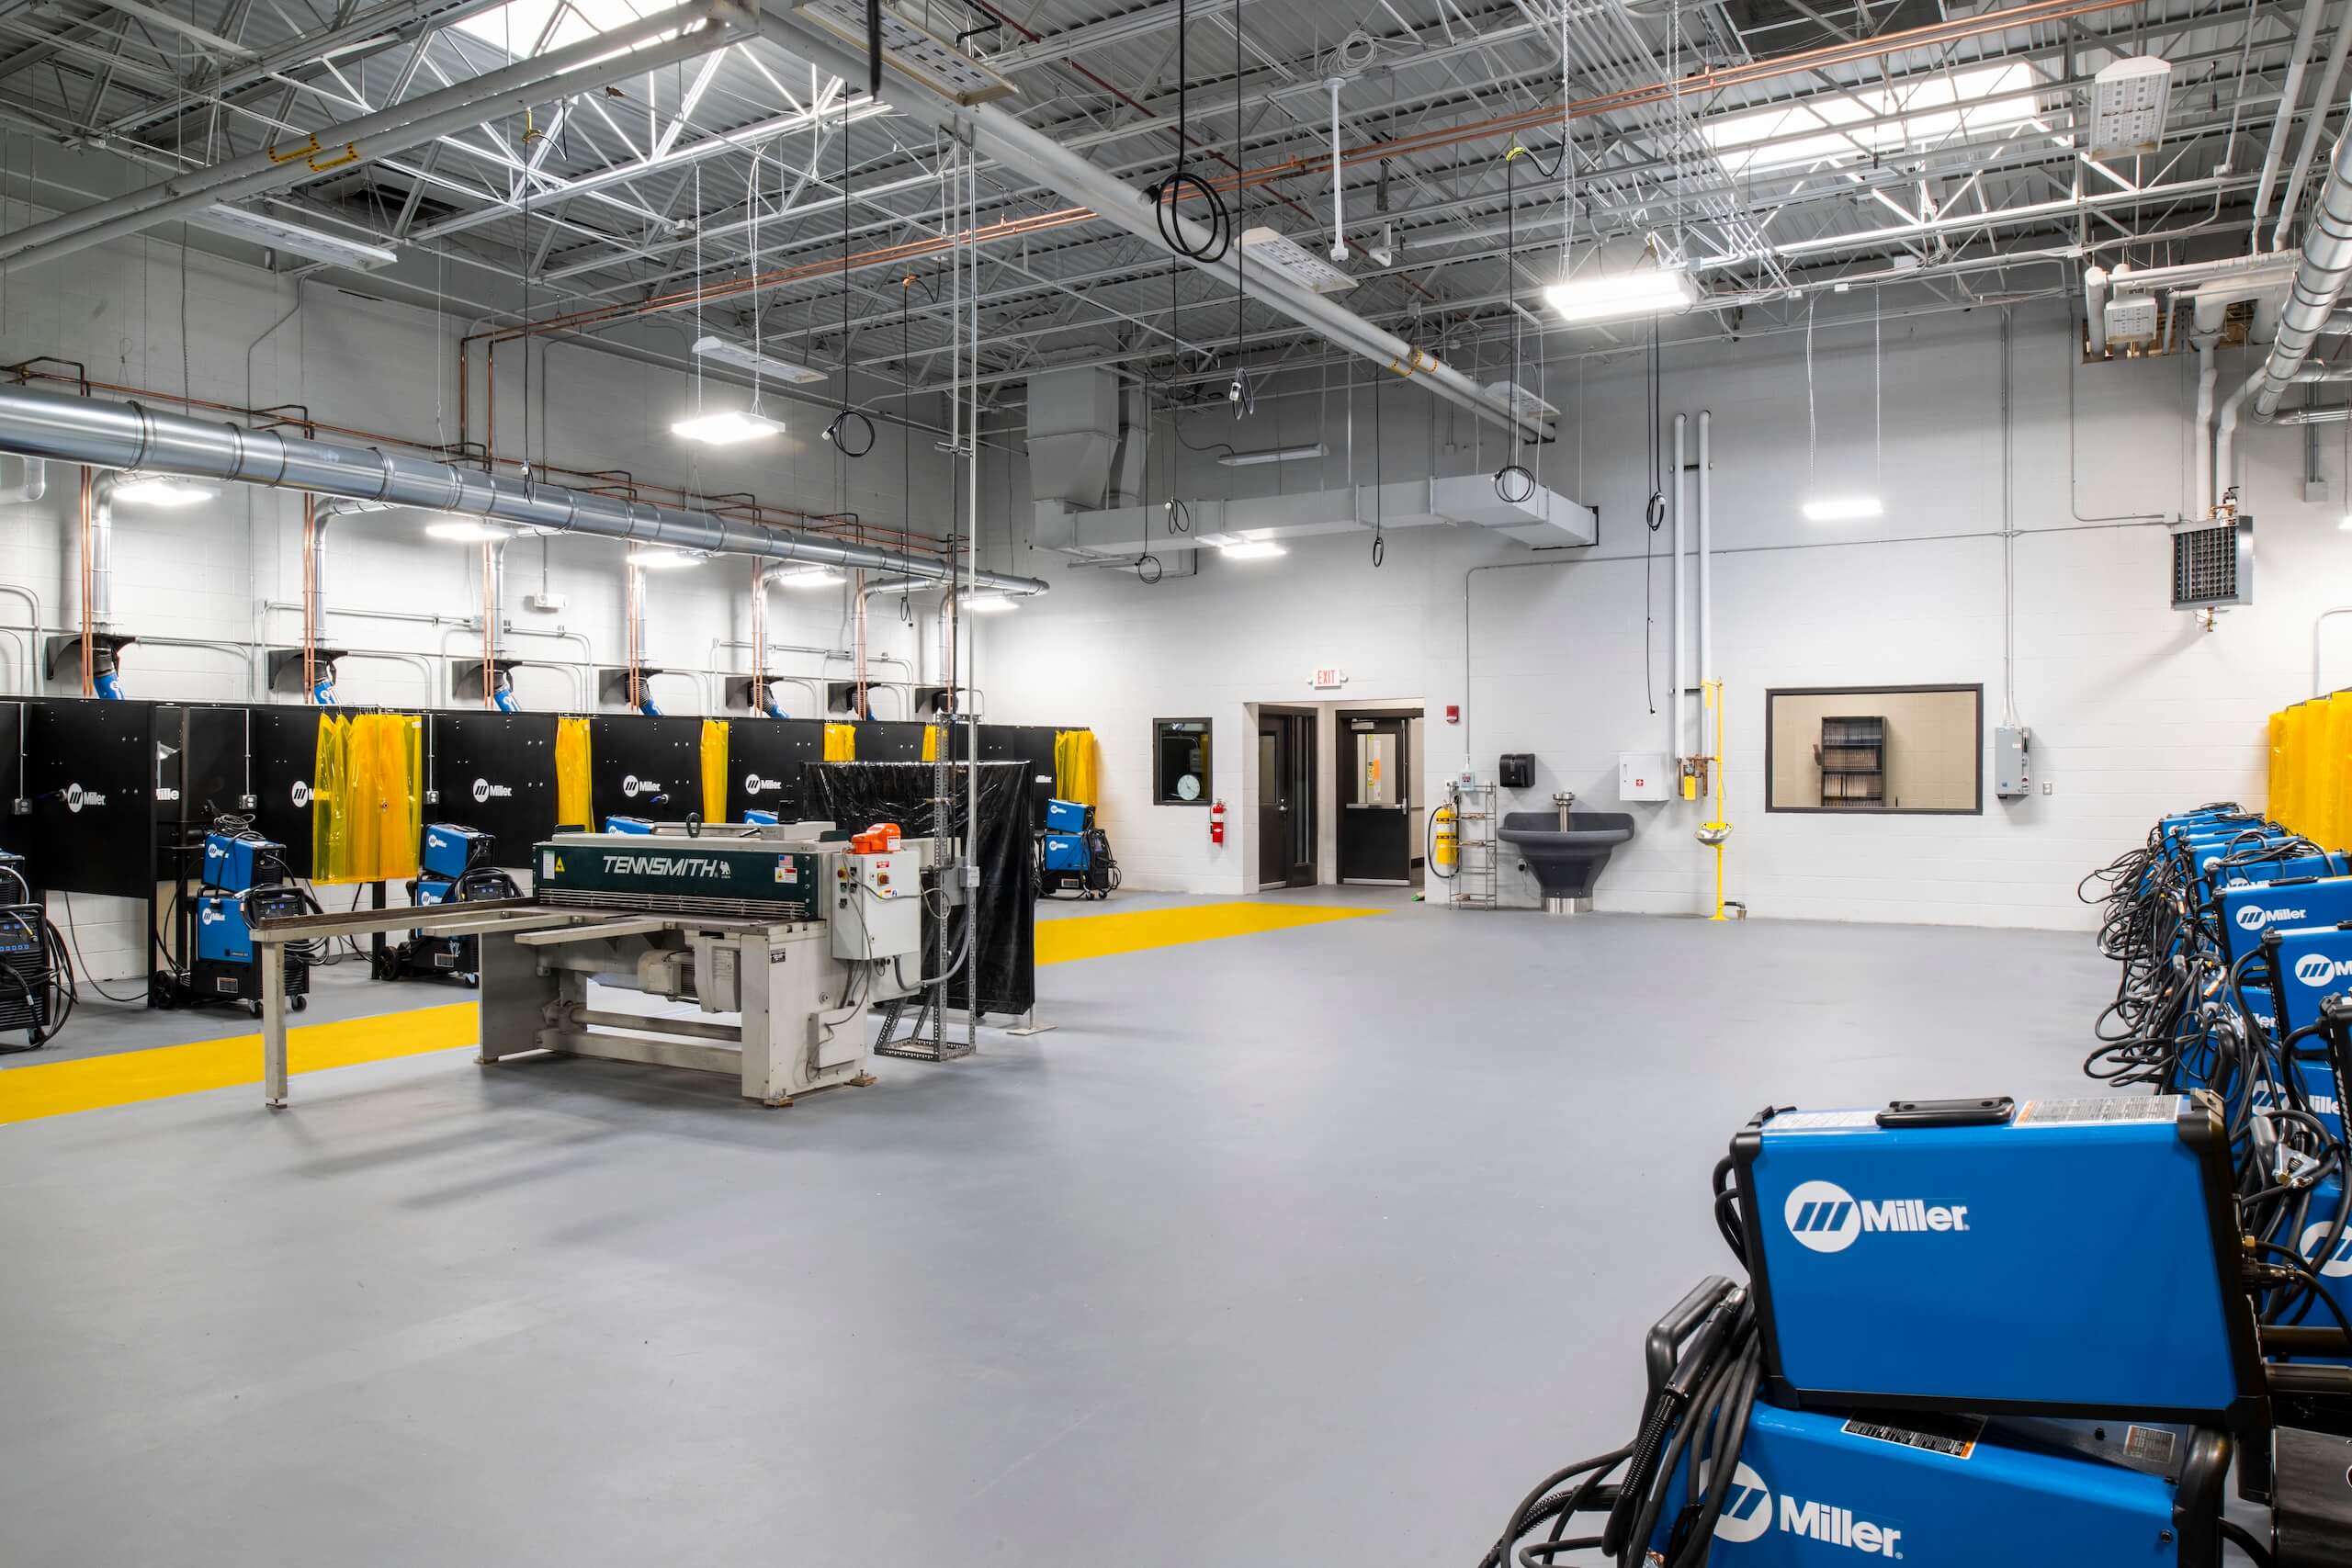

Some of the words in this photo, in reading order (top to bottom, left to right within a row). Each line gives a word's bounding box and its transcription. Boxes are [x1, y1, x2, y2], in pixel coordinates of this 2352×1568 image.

[1317, 670, 1335, 684] EXIT
[489, 784, 512, 797] Miller
[639, 781, 661, 792] Miller
[761, 780, 781, 790] Miller
[84, 791, 106, 806] Miller
[603, 855, 718, 878] TENNSMITH
[2265, 908, 2307, 922] Miller
[2309, 1094, 2340, 1115] ille
[1860, 1199, 1969, 1232] Miller
[1779, 1494, 1903, 1560] Miller
